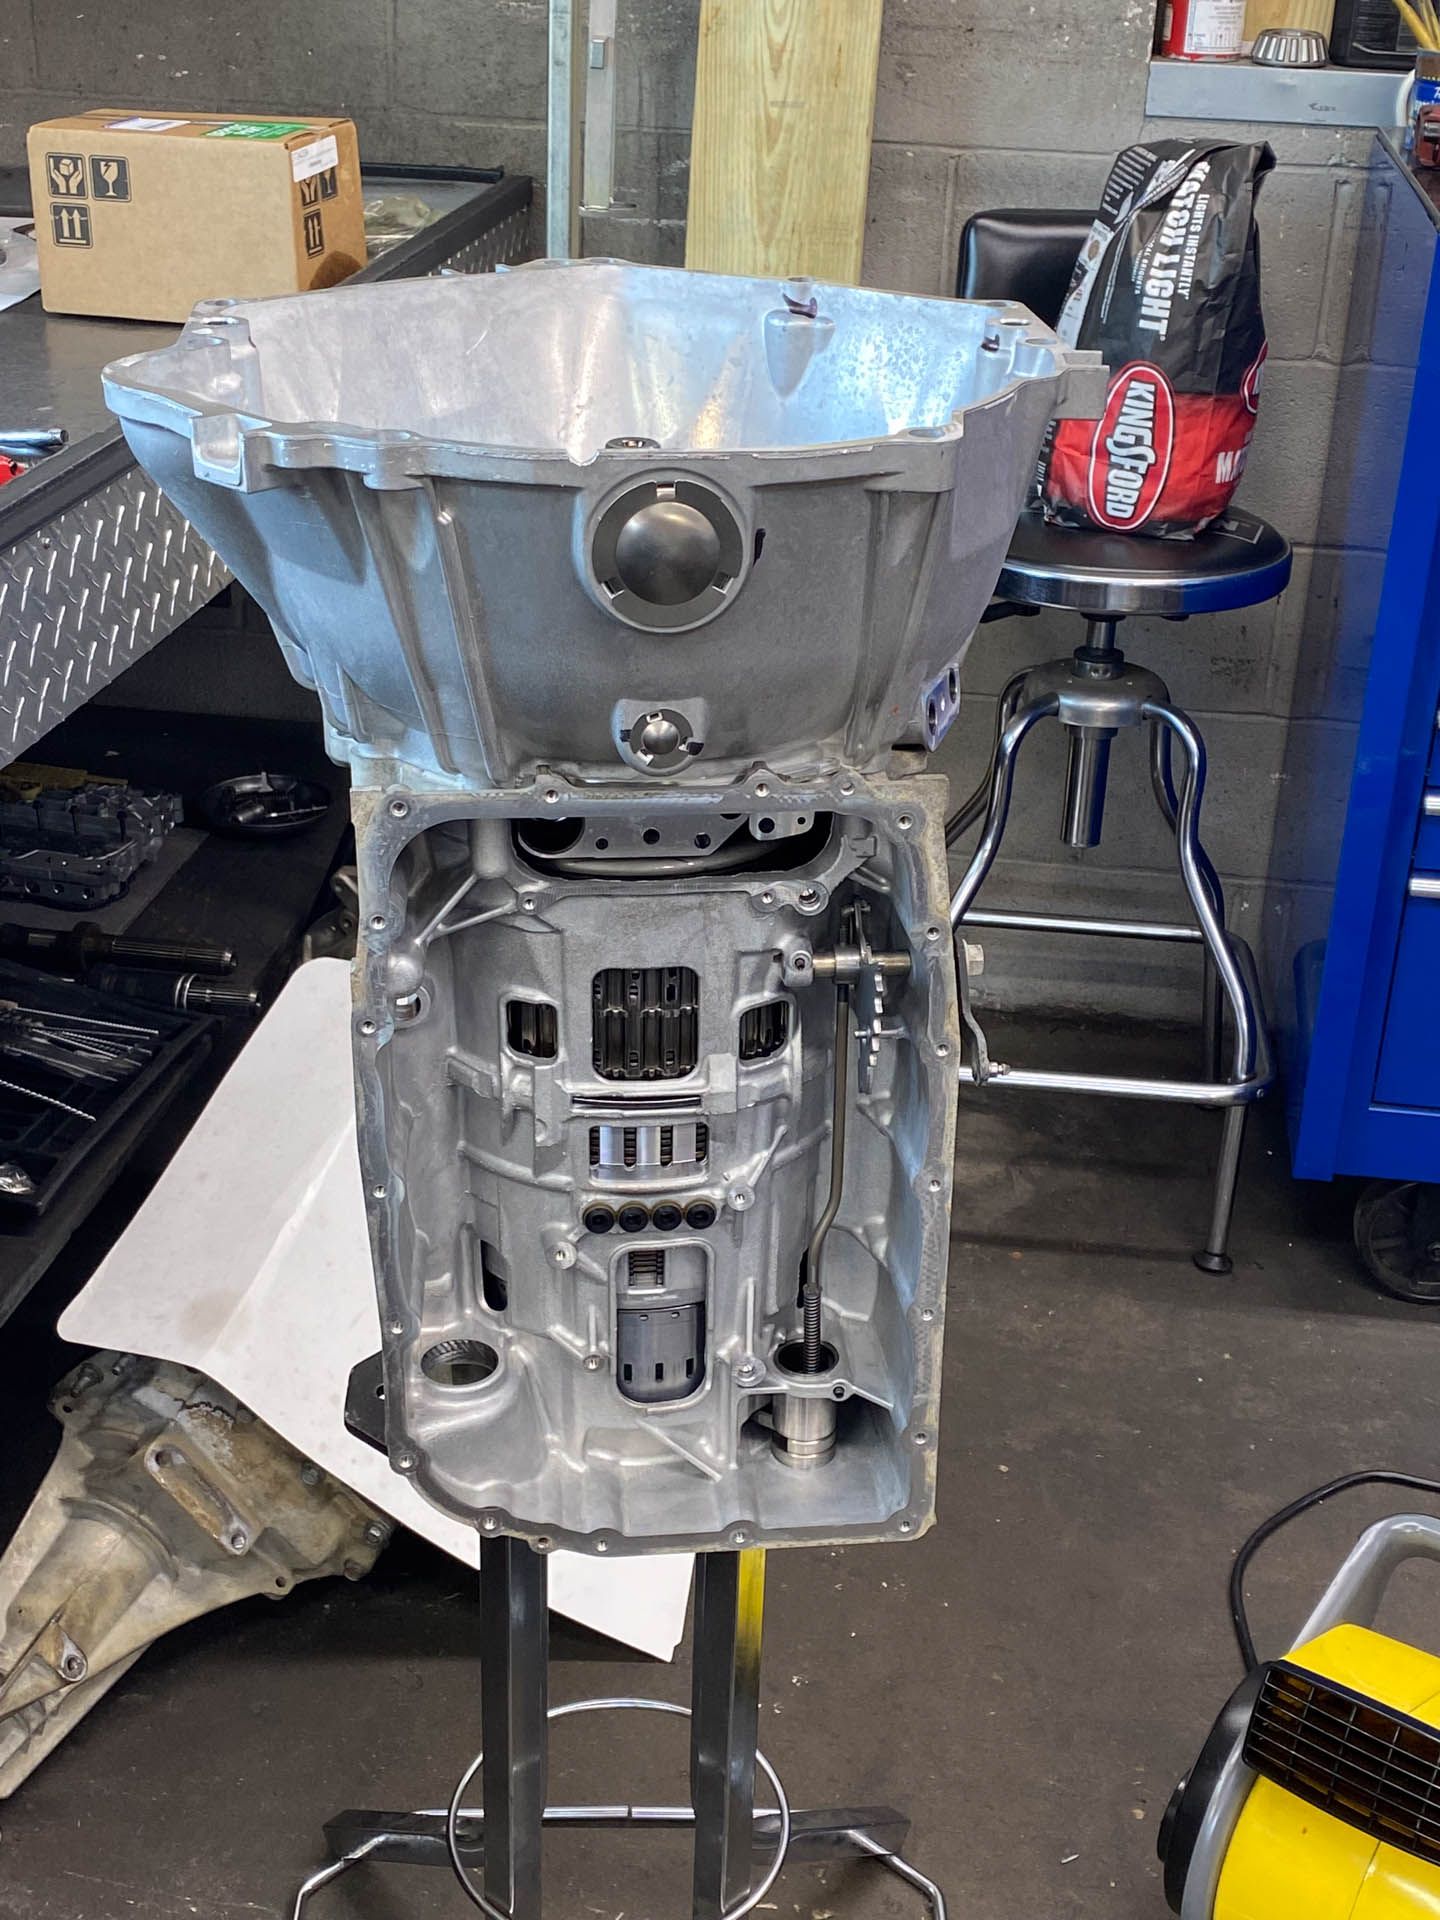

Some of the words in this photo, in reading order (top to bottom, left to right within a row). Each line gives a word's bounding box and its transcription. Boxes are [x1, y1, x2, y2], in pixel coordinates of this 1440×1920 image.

[1159, 161, 1211, 247] MATCH
[1190, 194, 1211, 233] LIGHTS
[1139, 252, 1181, 335] LIGHT
[1105, 380, 1156, 519] KINGSFORD
